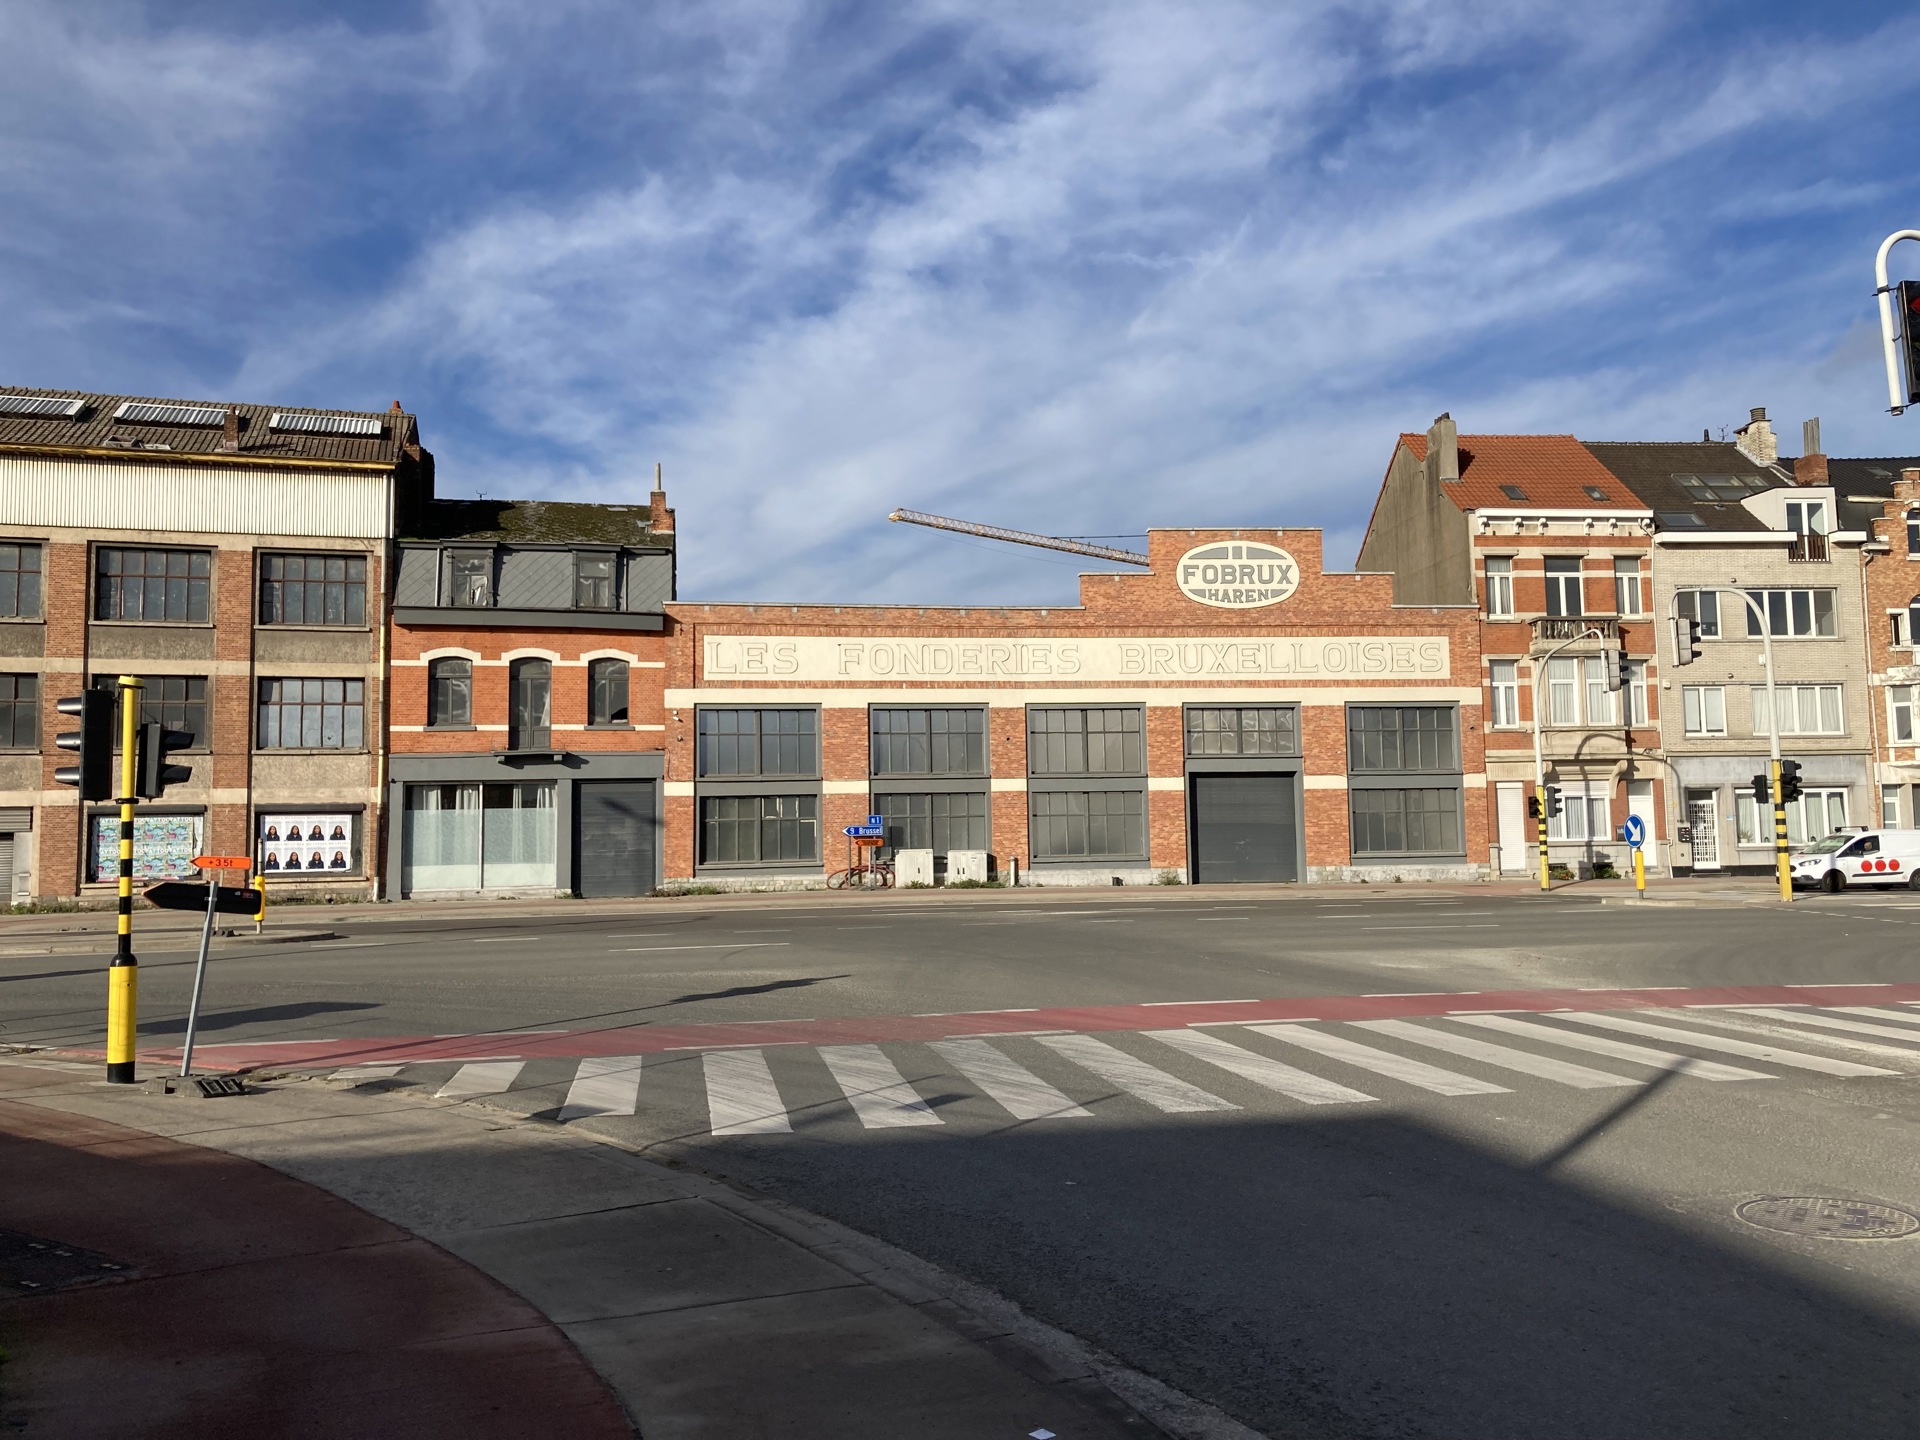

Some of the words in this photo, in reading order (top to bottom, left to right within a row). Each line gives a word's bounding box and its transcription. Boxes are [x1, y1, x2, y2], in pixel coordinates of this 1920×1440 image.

[1183, 564, 1293, 585] FOBRUX
[1207, 588, 1270, 603] HAREN
[707, 642, 799, 675] LES
[837, 643, 1081, 675] FONDERIES
[1117, 642, 1444, 675] BRUXELLOISES
[858, 827, 882, 835] Brussel
